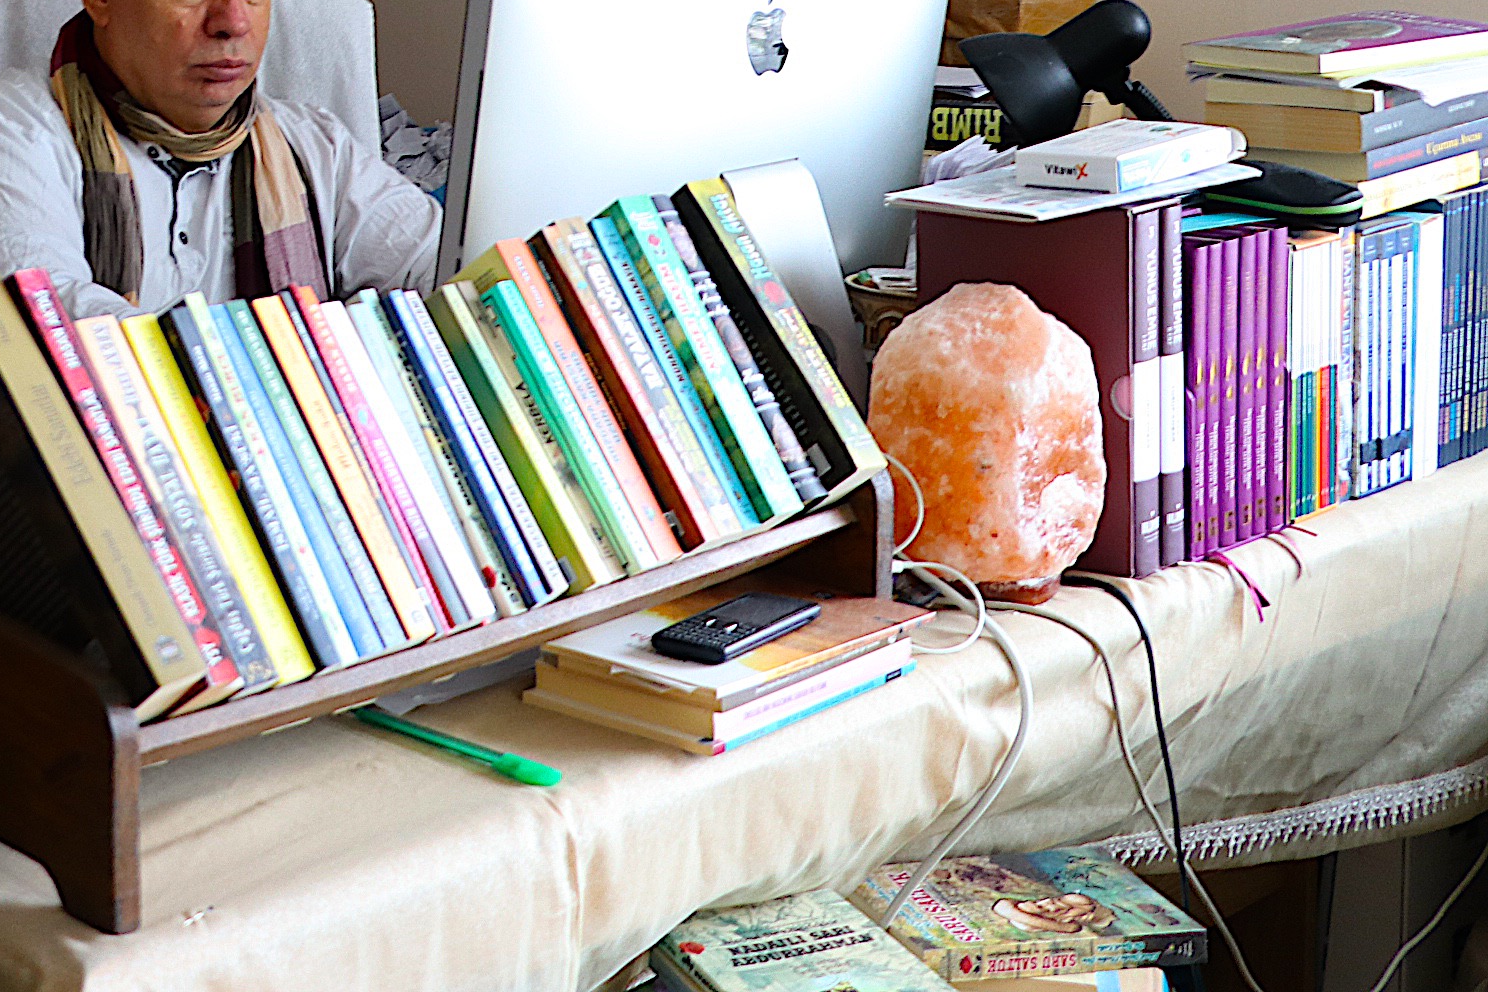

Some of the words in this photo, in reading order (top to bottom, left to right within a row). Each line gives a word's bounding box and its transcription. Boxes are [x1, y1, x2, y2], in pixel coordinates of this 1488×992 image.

[709, 188, 745, 237] Aktaş
[734, 231, 770, 283] Hasan
[1144, 248, 1156, 305] YUNUS
[1171, 243, 1182, 300] YUNUS
[31, 284, 64, 328] AKTAŞ
[585, 259, 622, 313] OĞUZ
[656, 259, 692, 317] HAŞİM
[49, 322, 82, 371] HASAN
[685, 315, 720, 373] AHMET
[1143, 307, 1156, 350] EMRE
[1170, 301, 1182, 344] EMRE
[612, 305, 665, 391] HAYALET
[78, 383, 121, 450] SANATLAR
[107, 443, 138, 486] EDEBİ
[124, 482, 163, 540] ŞİİRİNDE
[156, 467, 199, 531] SOSYAL
[149, 534, 179, 574] TÜRK
[166, 569, 201, 619] KLASİK
[208, 578, 234, 611] Türk
[222, 606, 258, 656] Çağdaş
[730, 933, 875, 968] ABDURRAHMAN
[809, 924, 852, 945] SARI
[1044, 950, 1079, 970] SARU
